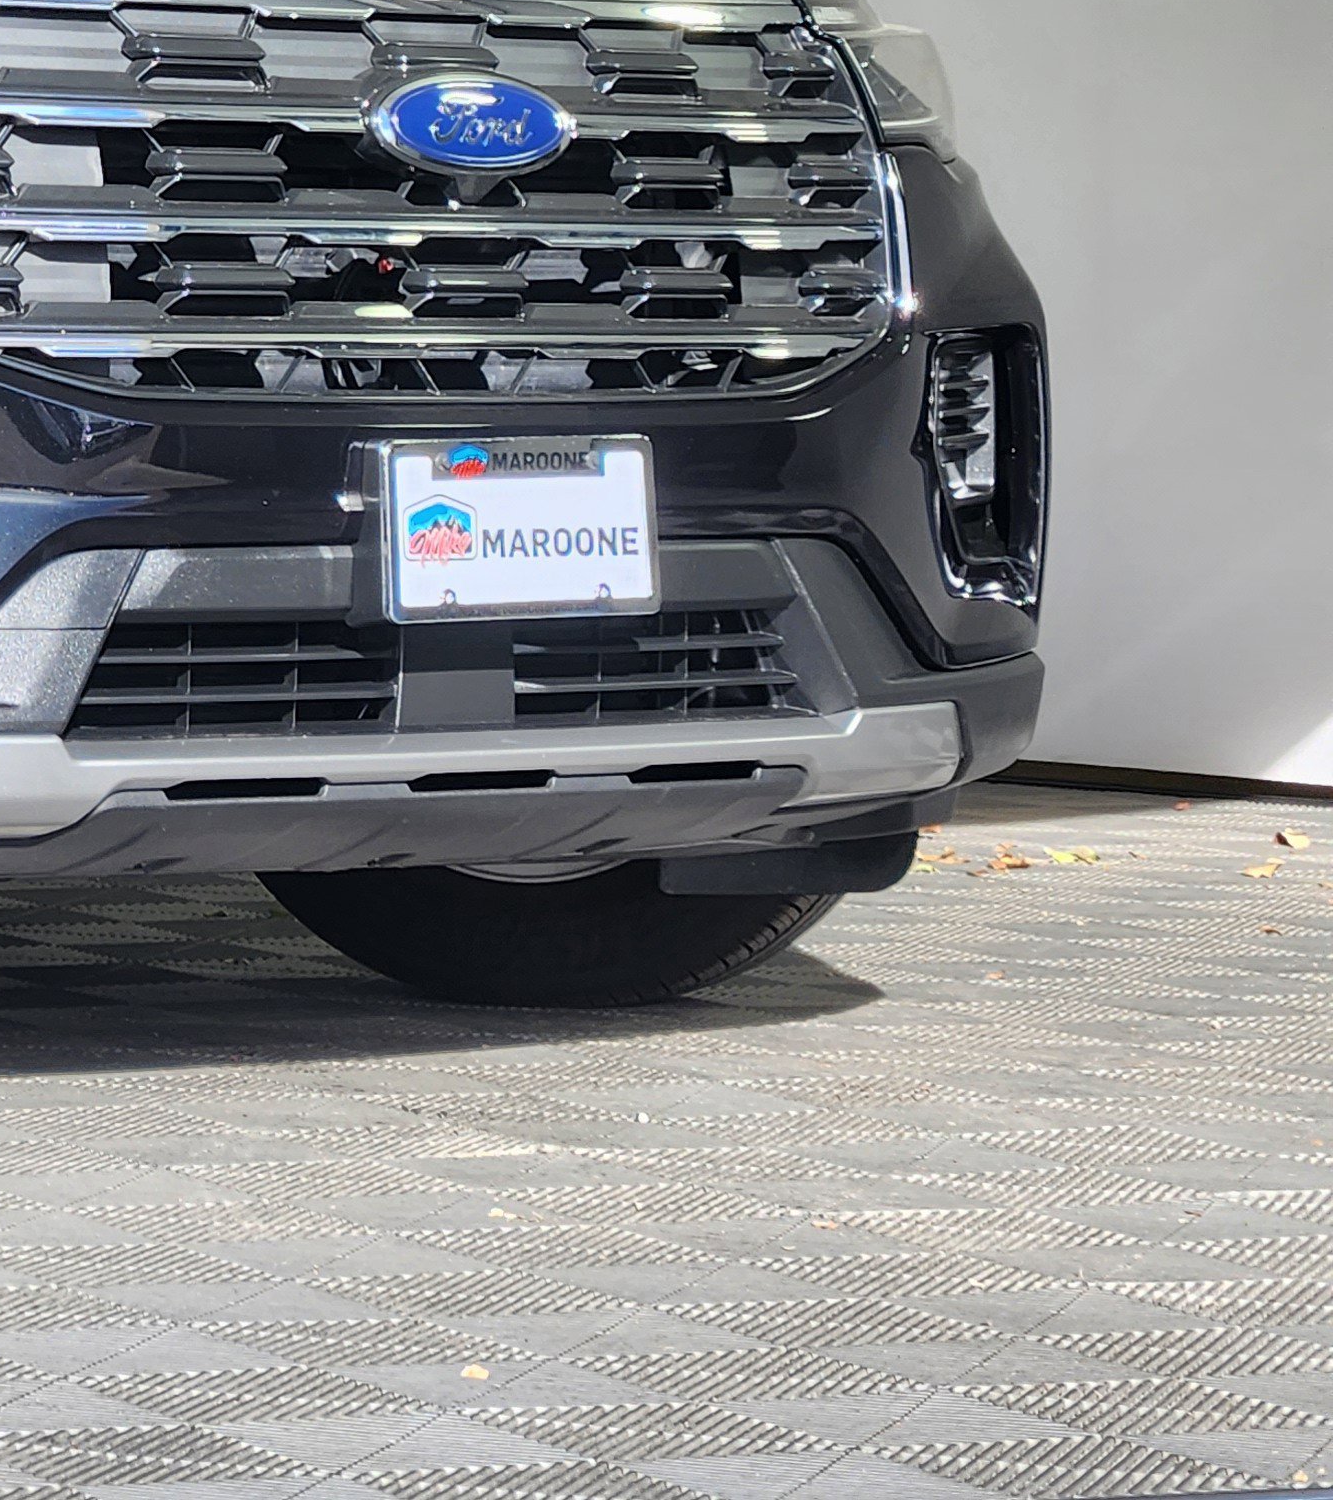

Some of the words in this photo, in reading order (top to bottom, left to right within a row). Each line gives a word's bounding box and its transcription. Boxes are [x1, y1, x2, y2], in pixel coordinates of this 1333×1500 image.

[428, 96, 534, 148] Ford
[491, 451, 590, 471] MAROONE
[482, 526, 639, 558] MAROONE
